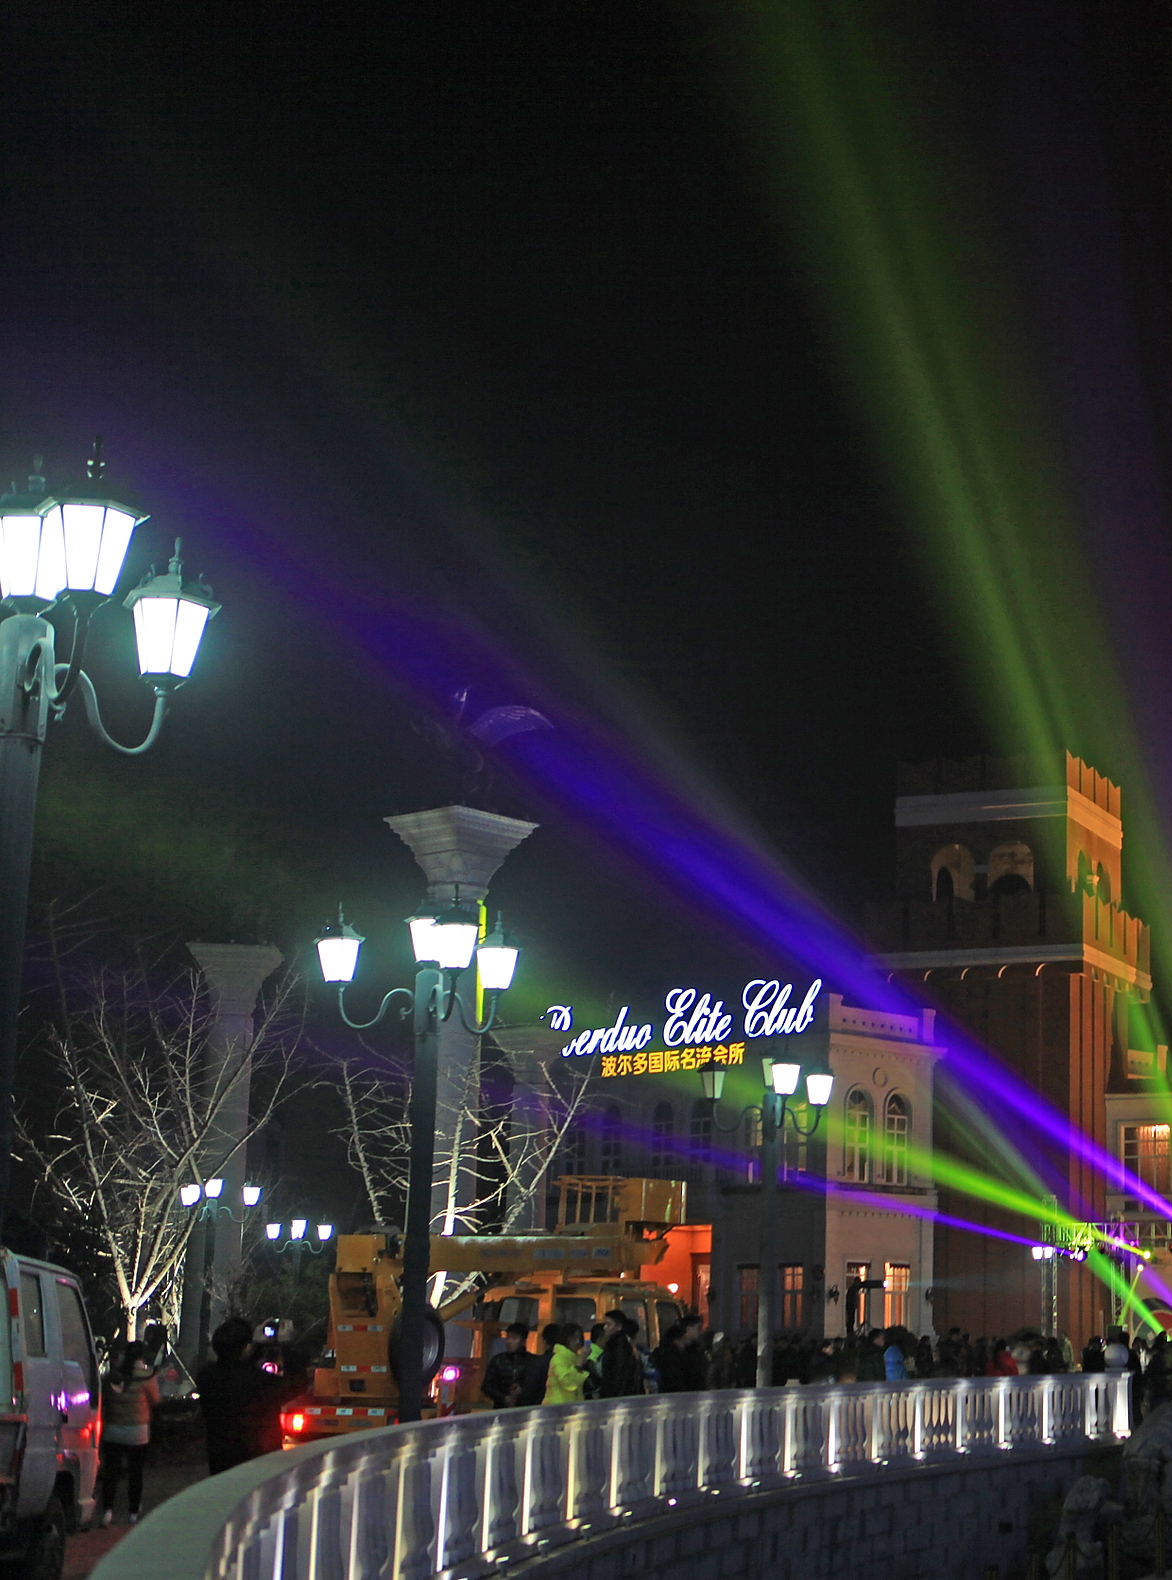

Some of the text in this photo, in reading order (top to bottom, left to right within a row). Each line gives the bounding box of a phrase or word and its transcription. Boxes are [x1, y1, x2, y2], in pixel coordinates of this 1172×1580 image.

[662, 988, 735, 1047] Elite
[741, 978, 822, 1038] Club
[601, 1041, 746, 1078] 波尔多国际名流会所
